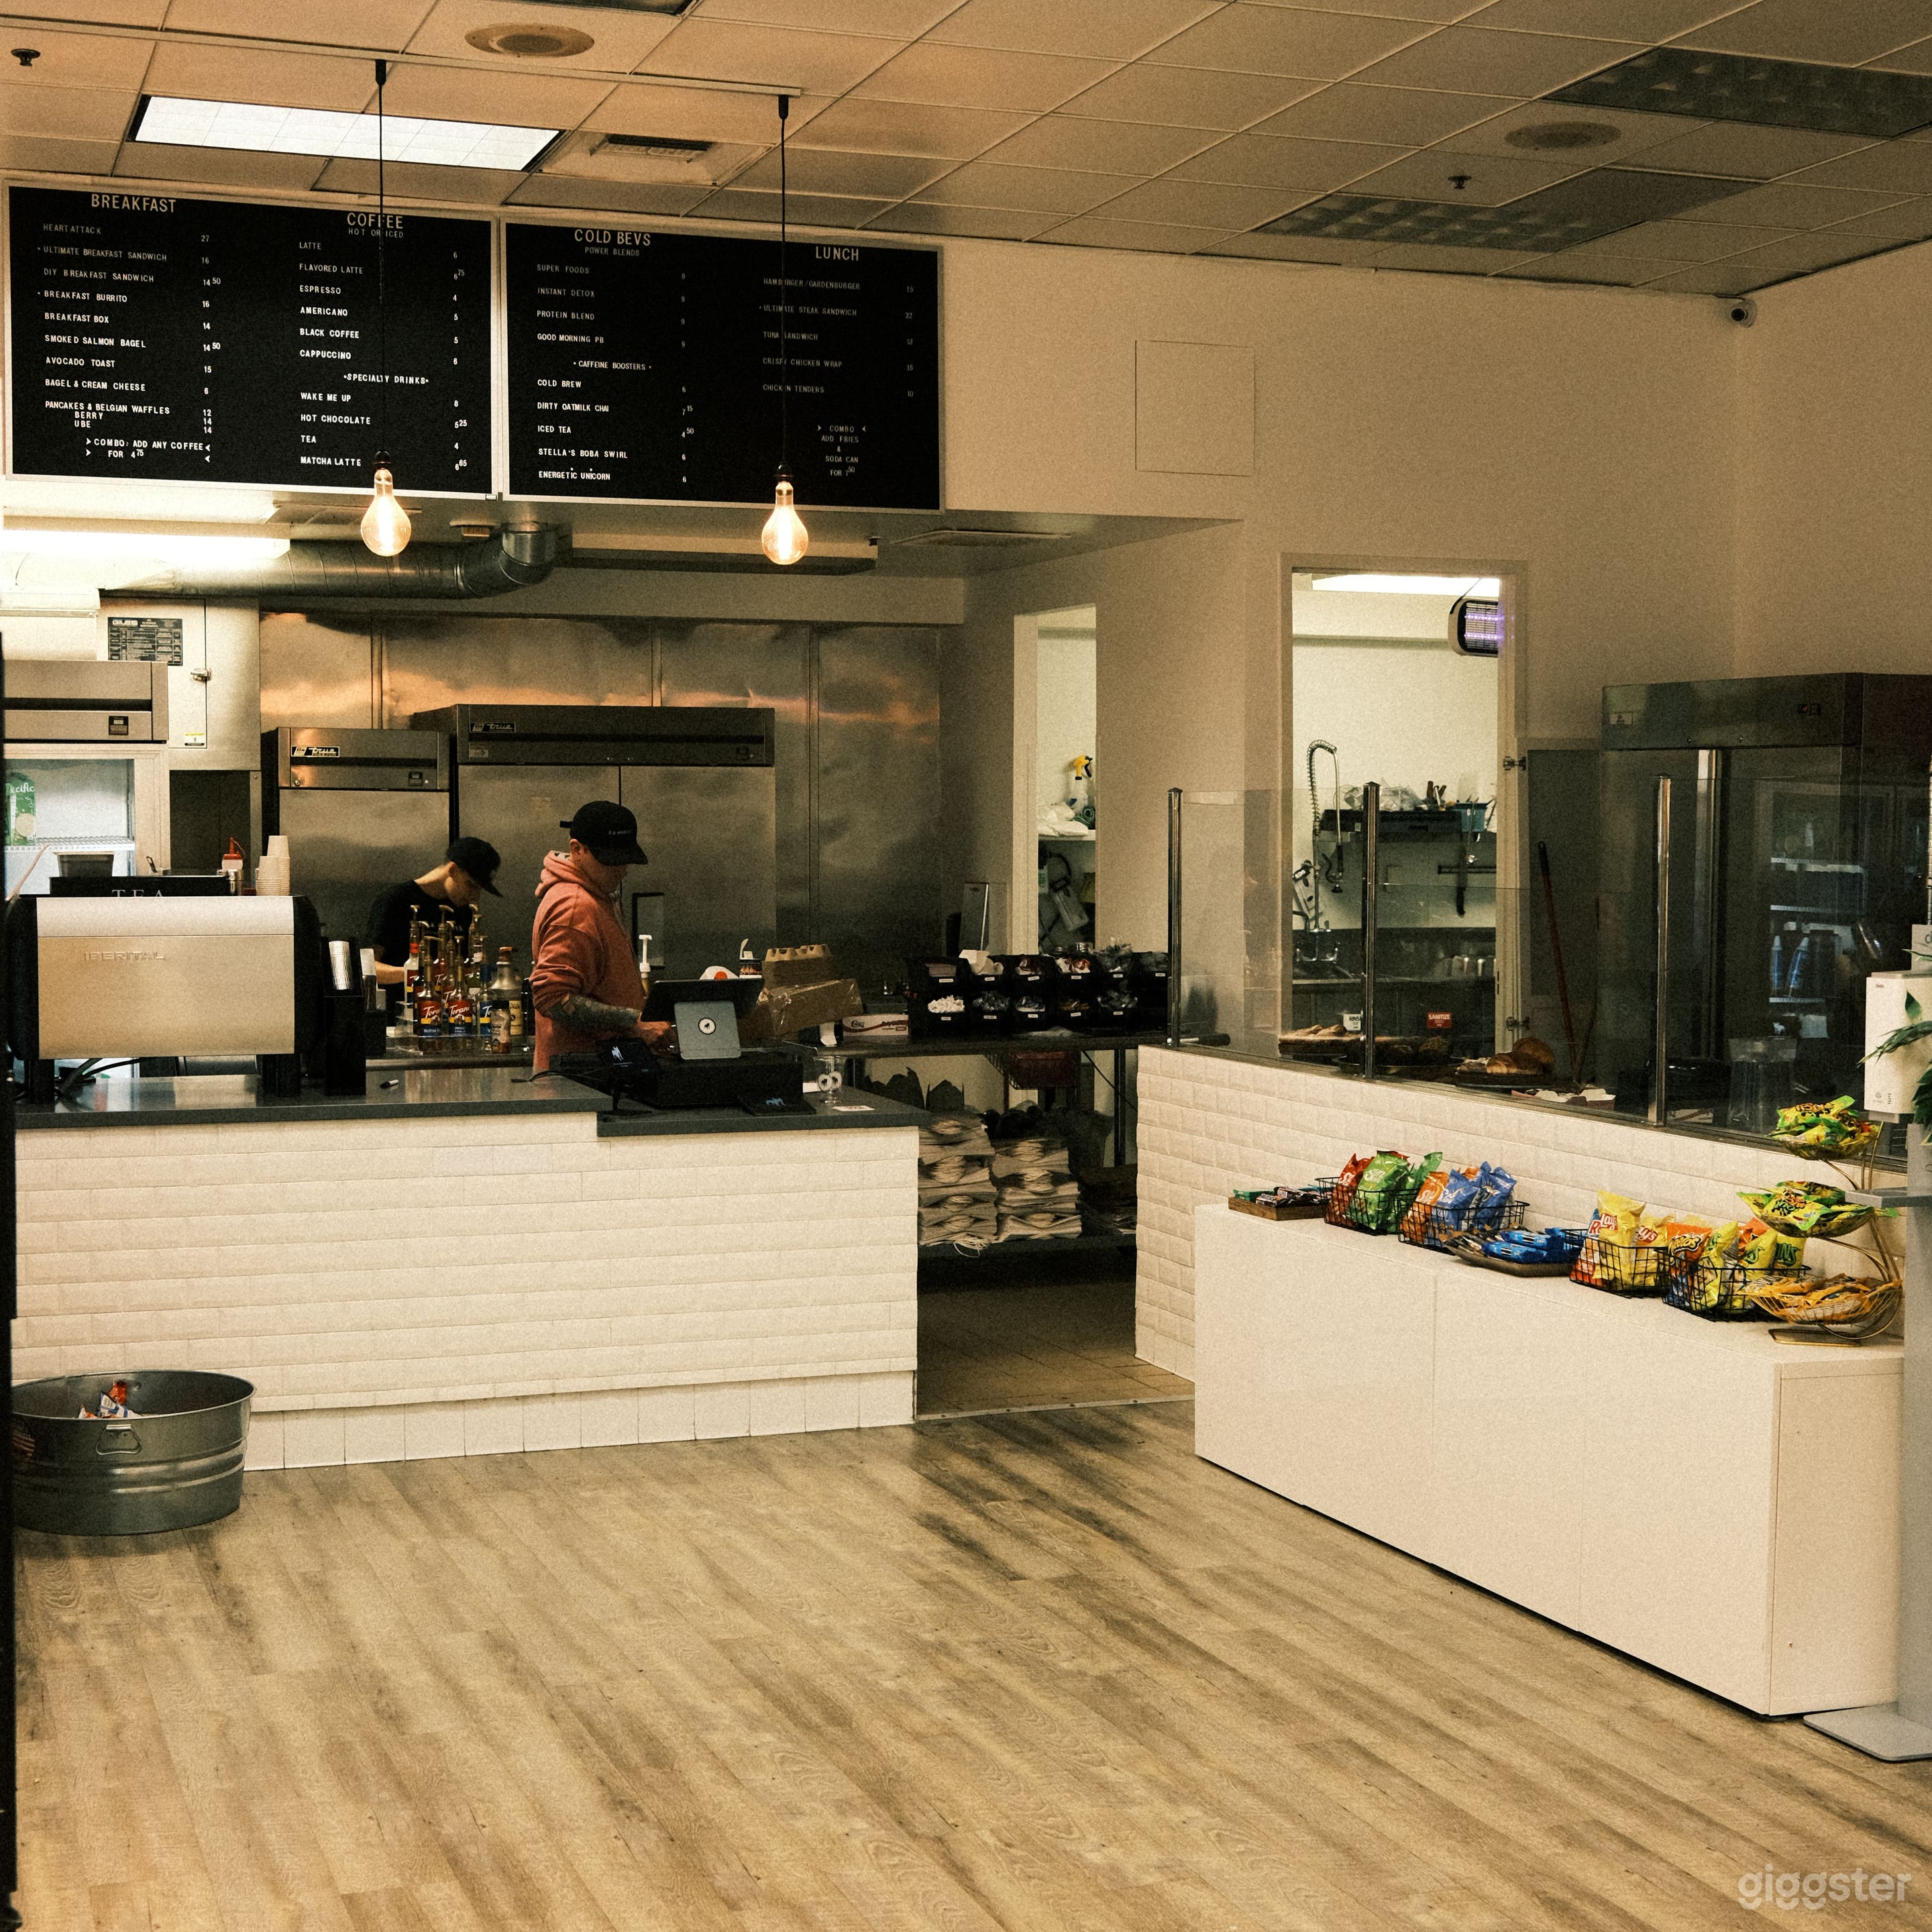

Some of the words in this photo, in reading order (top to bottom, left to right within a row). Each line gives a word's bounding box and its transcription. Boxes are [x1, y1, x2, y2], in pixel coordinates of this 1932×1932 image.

[91, 194, 176, 213] BREAKFAST
[347, 212, 403, 229] COFFEE
[44, 224, 68, 232] HEART
[70, 226, 101, 234] ATTACK
[575, 229, 611, 243] COLD
[617, 232, 650, 246] BEVS
[44, 246, 78, 255] ULTIMATE
[83, 249, 122, 258] BREAKFAST
[128, 252, 166, 261] SANDWICH
[816, 246, 859, 260] LUNCH
[300, 264, 337, 272] FLAVORED
[566, 266, 589, 274] FOODS
[64, 270, 106, 278] BREAKFAST
[113, 273, 154, 282] SANDWICH
[300, 285, 341, 294] ESPRESSO
[44, 290, 89, 300] BREAKFAST
[97, 294, 127, 302] BURRITO
[301, 307, 347, 316] AMERICANO
[45, 313, 91, 322] BREAKFAST
[300, 328, 324, 336] BLACK
[329, 330, 359, 338] COFFEE
[45, 335, 78, 343] SMOKED
[83, 337, 114, 345] SALMON
[121, 339, 146, 347] BAGEL
[300, 350, 351, 359] CAPPUCCINO
[46, 357, 85, 366] AVOCADO
[46, 379, 71, 387] BAGEL
[82, 381, 107, 389] CREAM
[113, 383, 145, 391] CHEESE
[301, 392, 323, 400] WAKE
[46, 401, 84, 410] PANCAKES
[96, 404, 127, 412] BELGIAN
[131, 405, 170, 414] WAFFLES
[75, 411, 103, 419] BERRY
[321, 415, 370, 424] CHOCOLATE
[171, 442, 203, 450] COFFEE
[335, 458, 361, 466] LATTE
[423, 1006, 441, 1019] Tora
[449, 1004, 470, 1018] Torani
